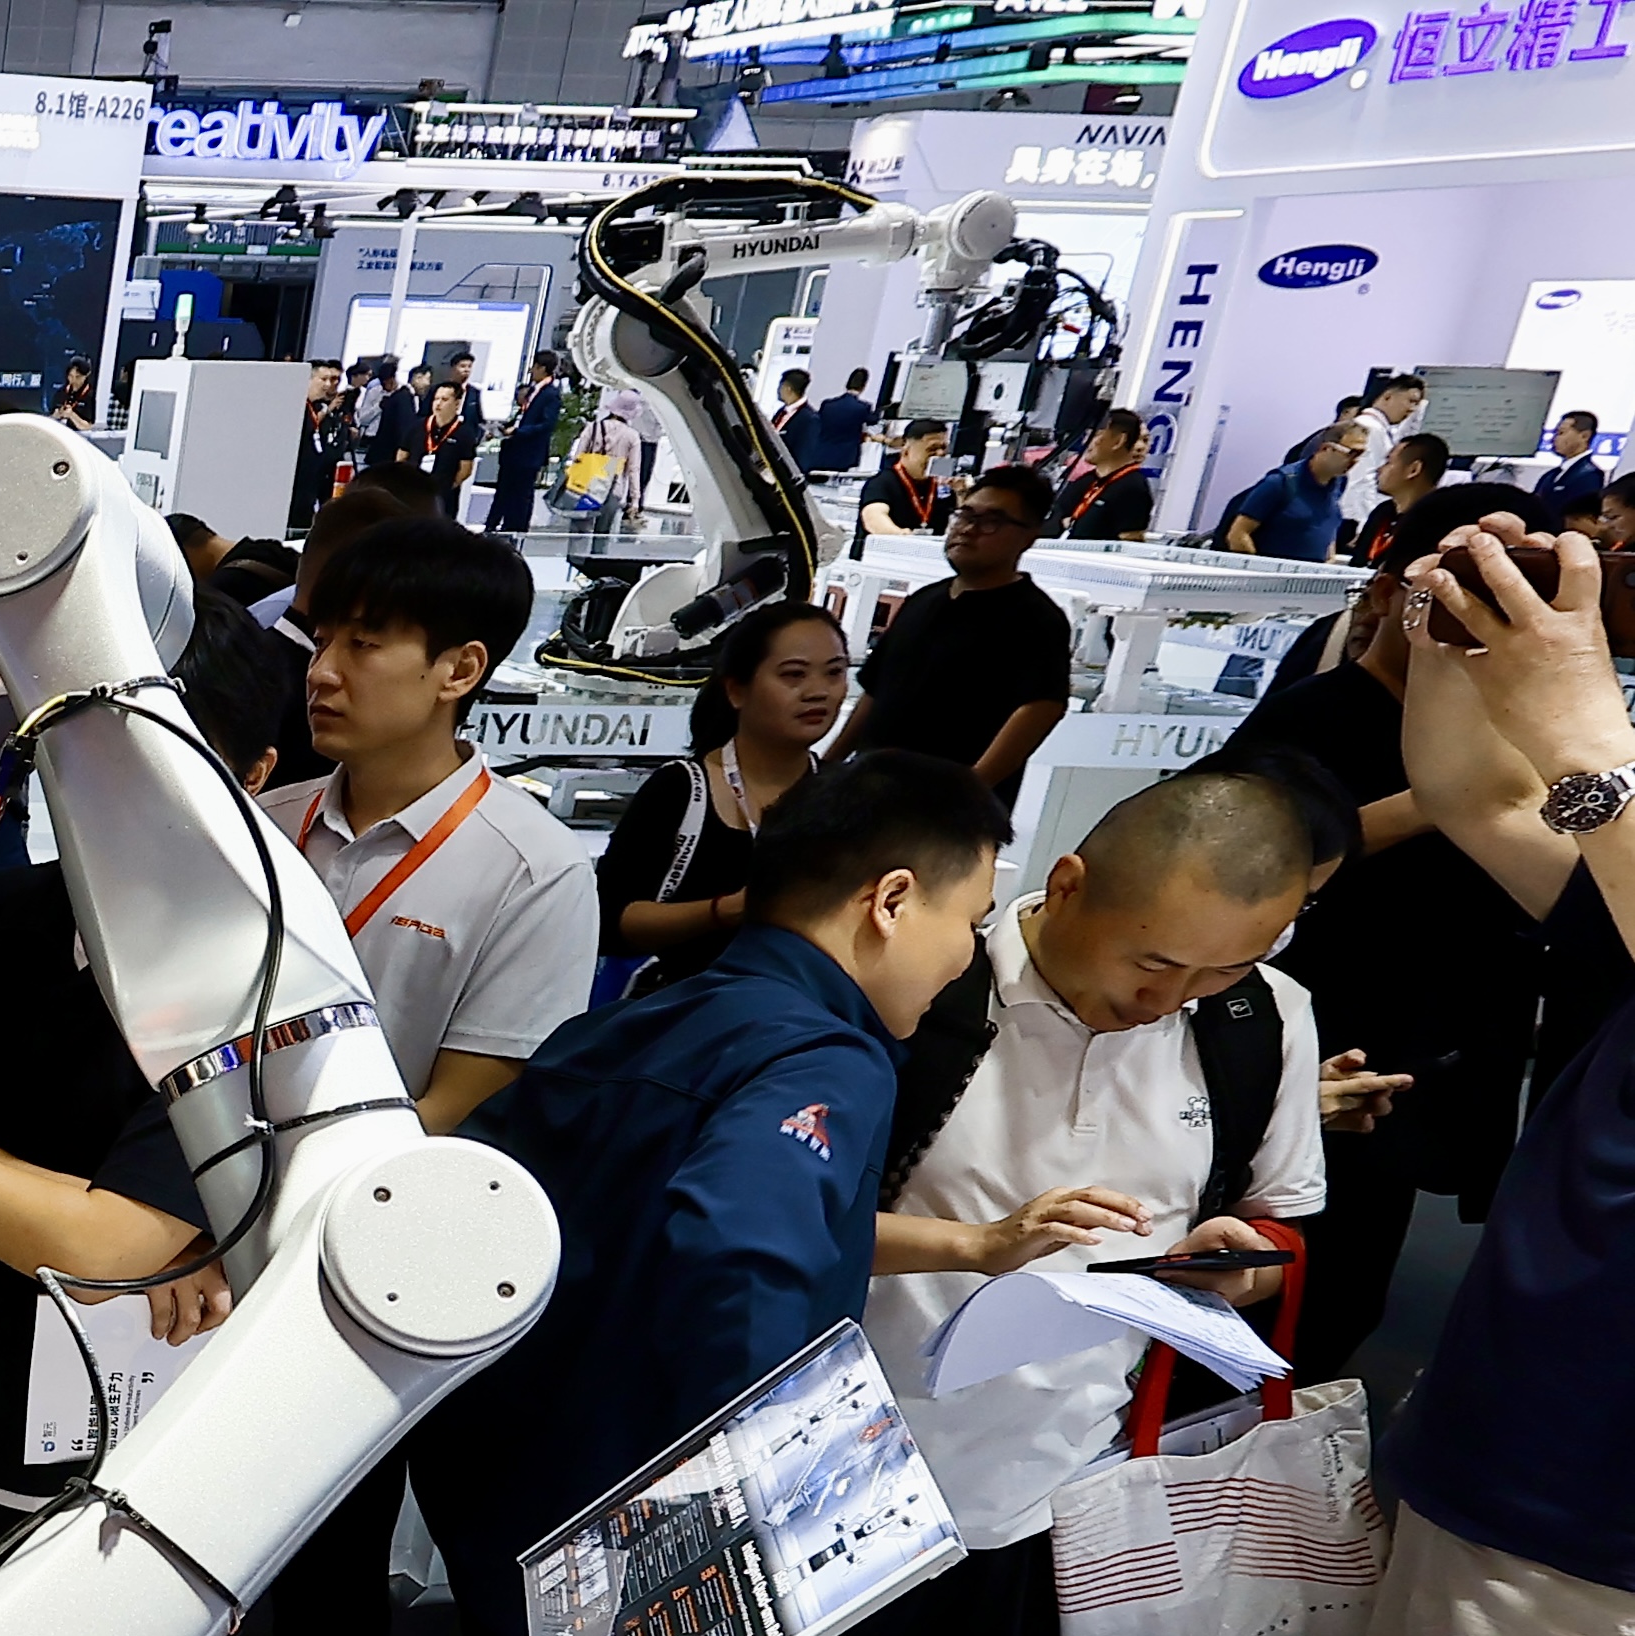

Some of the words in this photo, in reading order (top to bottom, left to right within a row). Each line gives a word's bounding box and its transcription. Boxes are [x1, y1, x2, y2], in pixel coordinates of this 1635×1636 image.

[1252, 37, 1363, 82] Hengli
[1388, 0, 1632, 84] 恒立精工
[35, 90, 146, 121] 8.1馆-A226
[147, 100, 388, 180] reativity
[732, 233, 820, 259] HYUNDAI
[1273, 257, 1367, 281] Hengli
